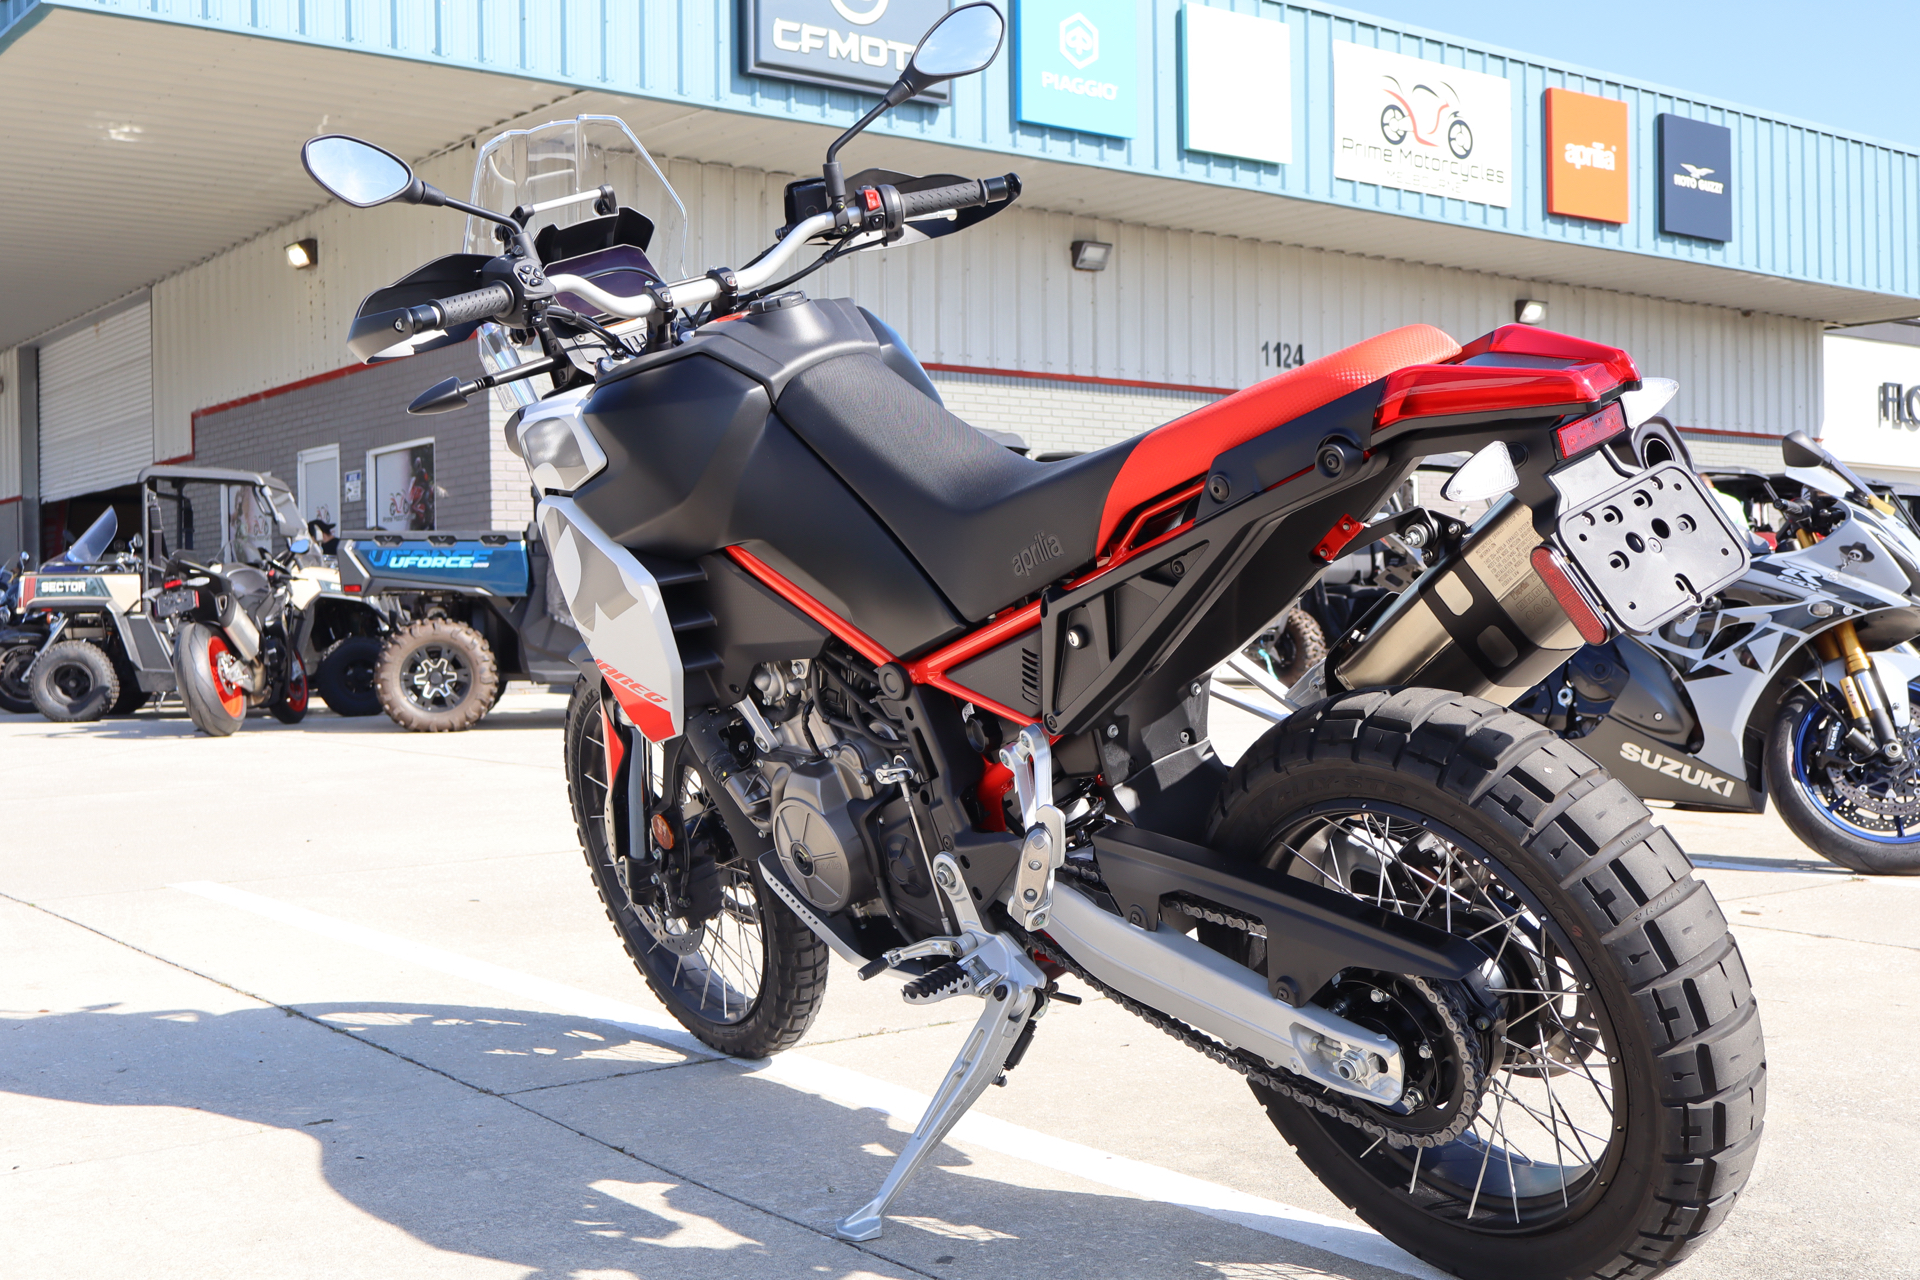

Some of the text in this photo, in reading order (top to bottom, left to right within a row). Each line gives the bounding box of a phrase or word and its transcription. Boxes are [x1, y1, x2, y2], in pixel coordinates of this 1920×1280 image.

[773, 17, 917, 71] CFMOT
[1041, 71, 1118, 100] PIAGGIO
[1342, 137, 1504, 184] Prime Motorcycles
[1564, 141, 1616, 171] aprilia
[1673, 173, 1724, 194] MOTO GUZZI
[1261, 341, 1305, 369] 1124
[389, 556, 475, 568] UFORCE
[1011, 530, 1065, 577] aprilia
[41, 581, 87, 593] SECTOR
[1827, 721, 1842, 750] brembo
[1619, 742, 1735, 798] SUZUKI
